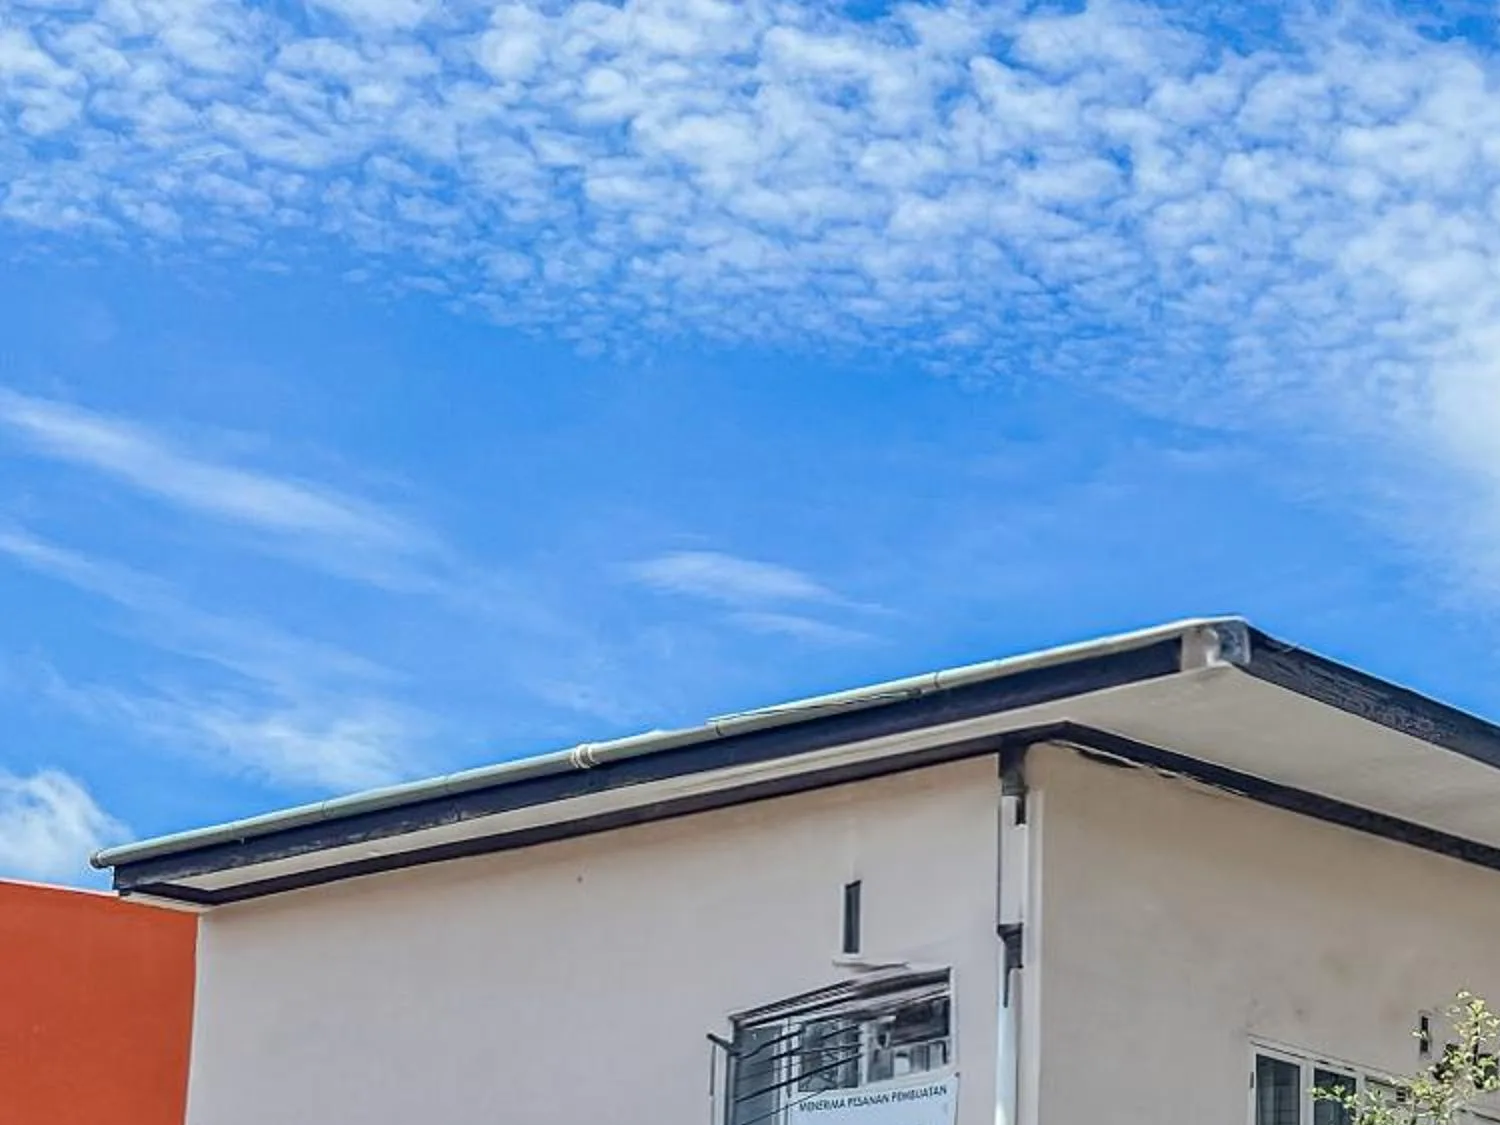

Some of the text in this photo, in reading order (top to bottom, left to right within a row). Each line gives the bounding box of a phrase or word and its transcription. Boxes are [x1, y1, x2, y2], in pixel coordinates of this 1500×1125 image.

[799, 1085, 947, 1112] MENERIMA PESANAN PEMBUATAN
